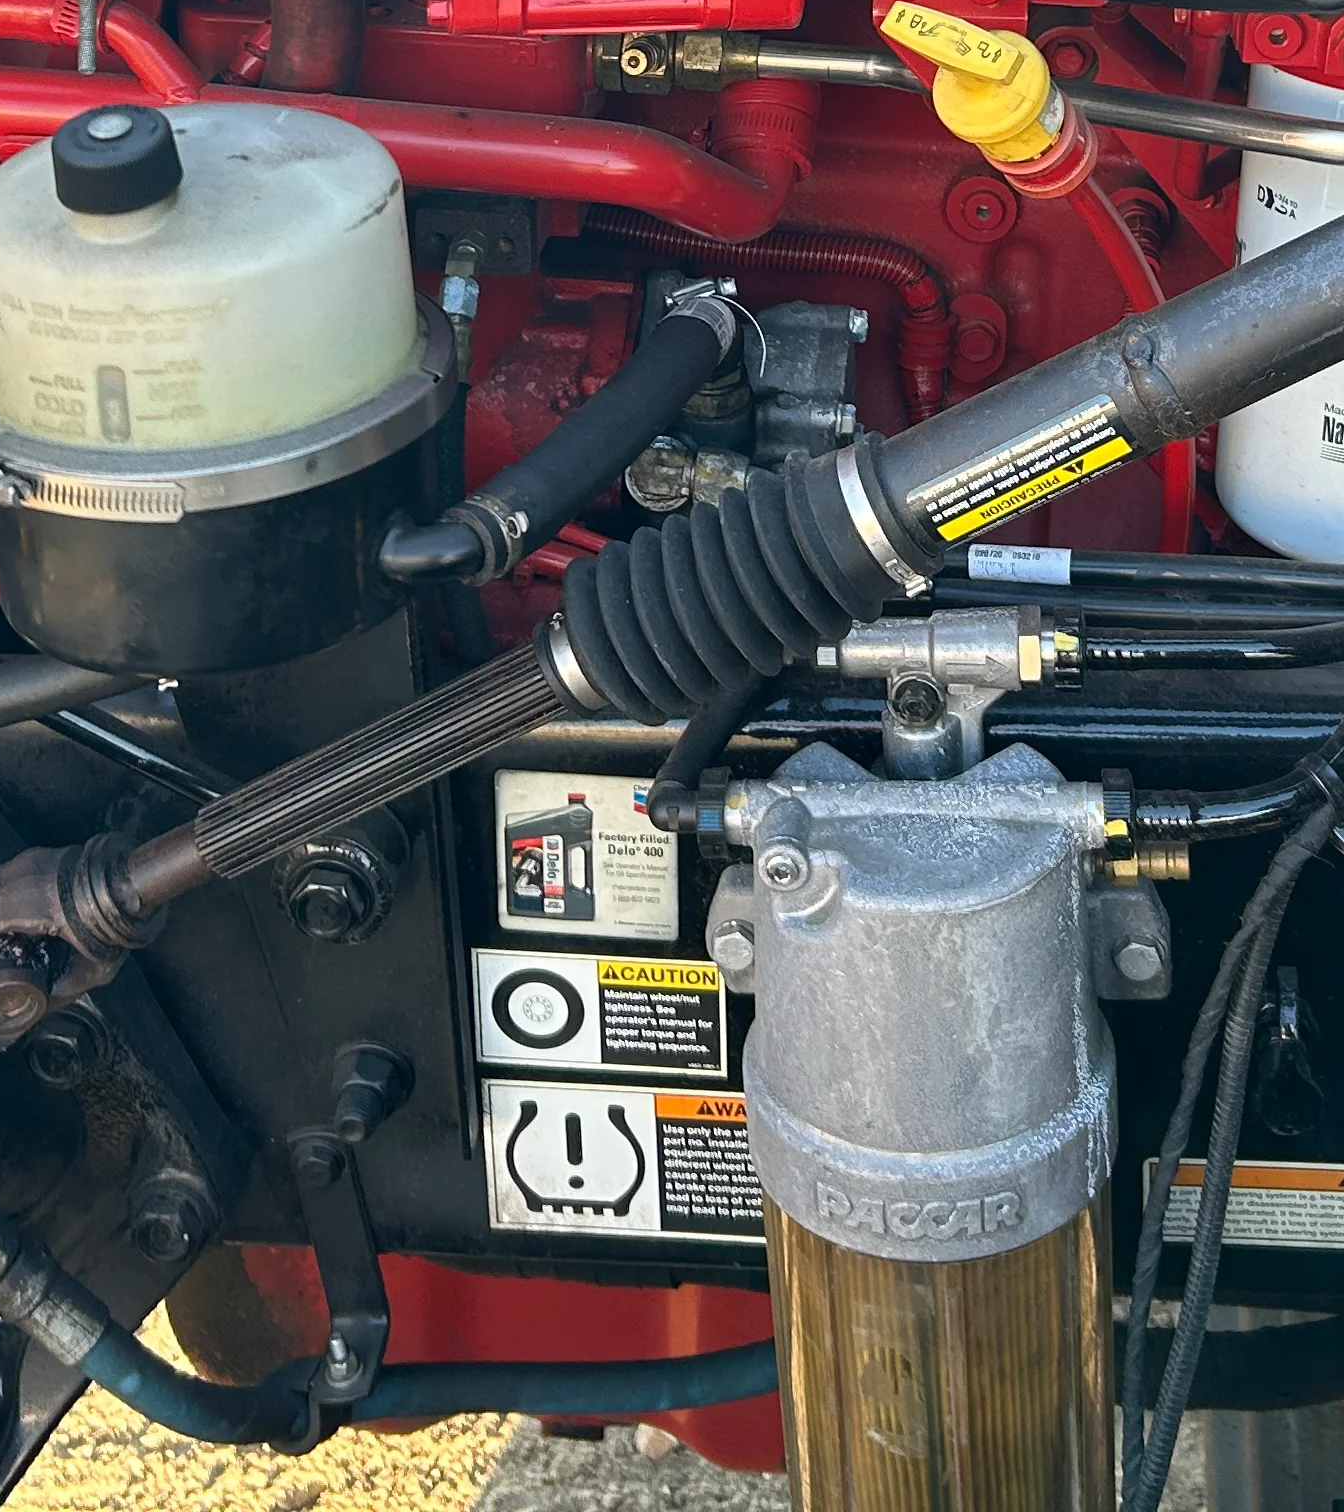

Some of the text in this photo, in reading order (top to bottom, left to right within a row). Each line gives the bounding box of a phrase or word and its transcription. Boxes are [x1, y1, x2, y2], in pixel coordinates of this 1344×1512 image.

[1069, 430, 1082, 441] de
[1019, 469, 1031, 480] de
[979, 475, 1062, 520] PRECAUCION
[598, 832, 672, 845] Factory Filled:
[643, 845, 664, 857] 400
[547, 853, 560, 879] Delo
[620, 966, 716, 985] CAUTION
[604, 989, 700, 1004] Maintain wheel/nut
[604, 1015, 657, 1026] operator's
[658, 1018, 696, 1028] manual
[605, 1027, 696, 1040] proper torque and
[606, 1038, 710, 1054] tightening sequence.
[714, 1101, 747, 1117] WA
[662, 1124, 685, 1135] Use
[686, 1126, 712, 1138] only
[713, 1127, 732, 1137] the
[663, 1136, 749, 1149] part no. installe
[664, 1149, 722, 1160] equipment
[664, 1158, 746, 1172] different wheel
[664, 1171, 698, 1180] cause
[699, 1172, 729, 1182] valve
[674, 1181, 706, 1192] brake
[665, 1192, 690, 1202] lead
[691, 1193, 704, 1203] to
[705, 1194, 729, 1204] loss
[730, 1196, 744, 1205] of
[666, 1204, 763, 1219] may lead to perso
[815, 1181, 1026, 1239] PACCAR
